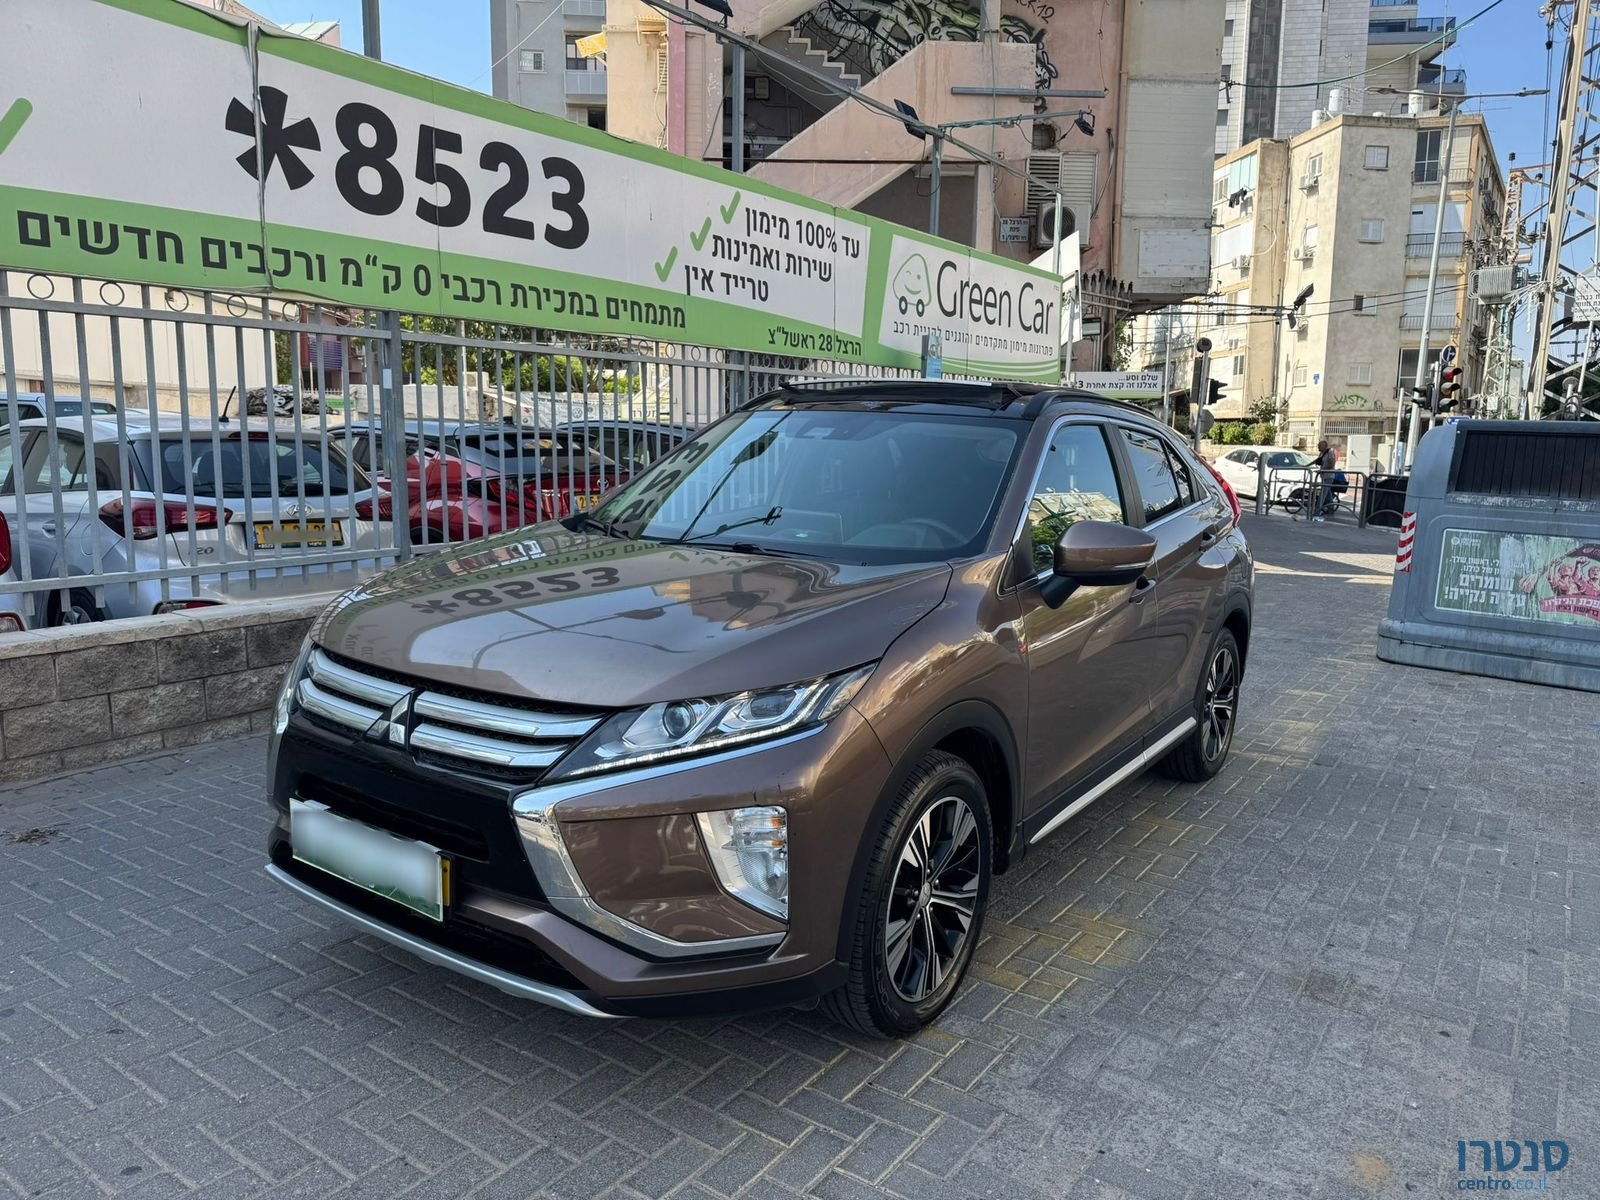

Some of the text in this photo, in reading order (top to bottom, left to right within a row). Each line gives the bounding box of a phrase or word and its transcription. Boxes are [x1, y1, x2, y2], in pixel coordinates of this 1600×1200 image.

[17, 210, 184, 264] חדשים
[745, 207, 860, 258] עד 100% מימון
[201, 236, 327, 282] ורכבים
[712, 234, 832, 282] שירות ואמינות
[413, 263, 432, 296] 0
[440, 273, 501, 306] רכבי
[684, 264, 769, 302] טרייד אין
[510, 283, 599, 318] במכירת
[936, 260, 1054, 335] Green Car
[605, 296, 685, 328] מתמחים
[893, 321, 910, 335] רכב
[818, 333, 833, 352] 28
[835, 335, 862, 356] הרצל
[975, 335, 1008, 350] מתקדמים
[1010, 339, 1028, 353] מימון
[1028, 343, 1053, 357] פתרונות
[1086, 381, 1107, 389] אחרת
[1108, 381, 1125, 390] קצת
[1126, 381, 1135, 389] זה
[1136, 381, 1158, 389] אצלנו
